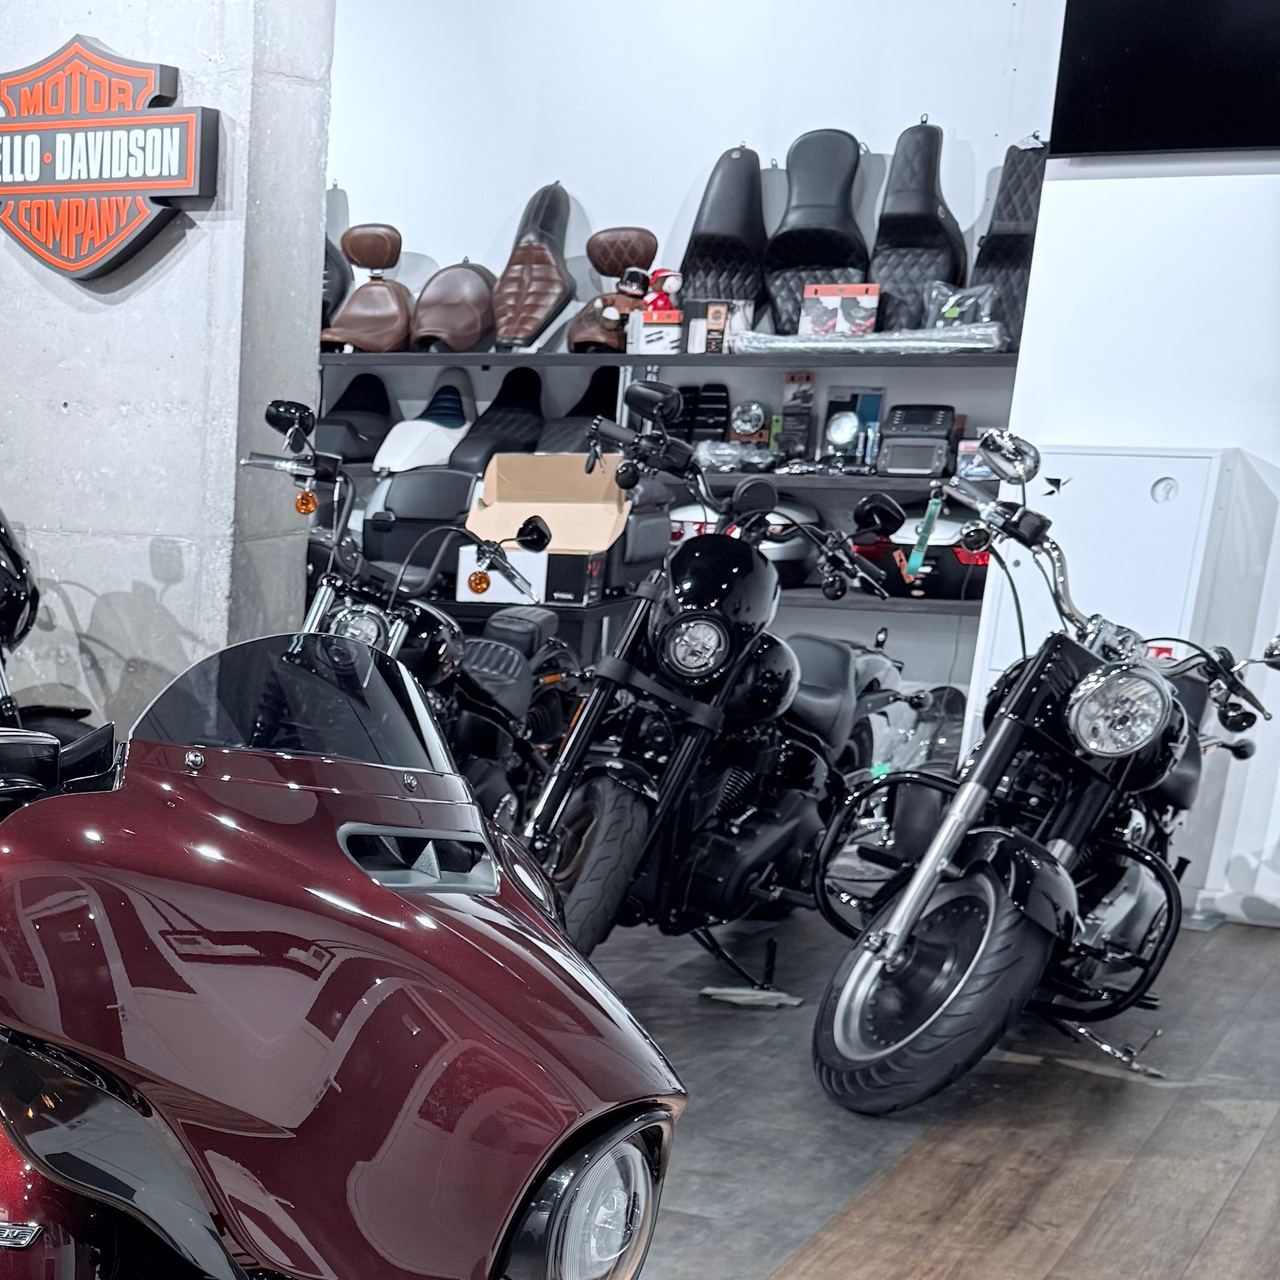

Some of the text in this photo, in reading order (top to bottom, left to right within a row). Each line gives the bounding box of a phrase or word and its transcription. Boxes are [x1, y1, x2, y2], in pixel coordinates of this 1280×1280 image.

[20, 59, 133, 116] MOTOR
[55, 127, 180, 181] DAVIDSON
[18, 196, 132, 259] COMPANY
